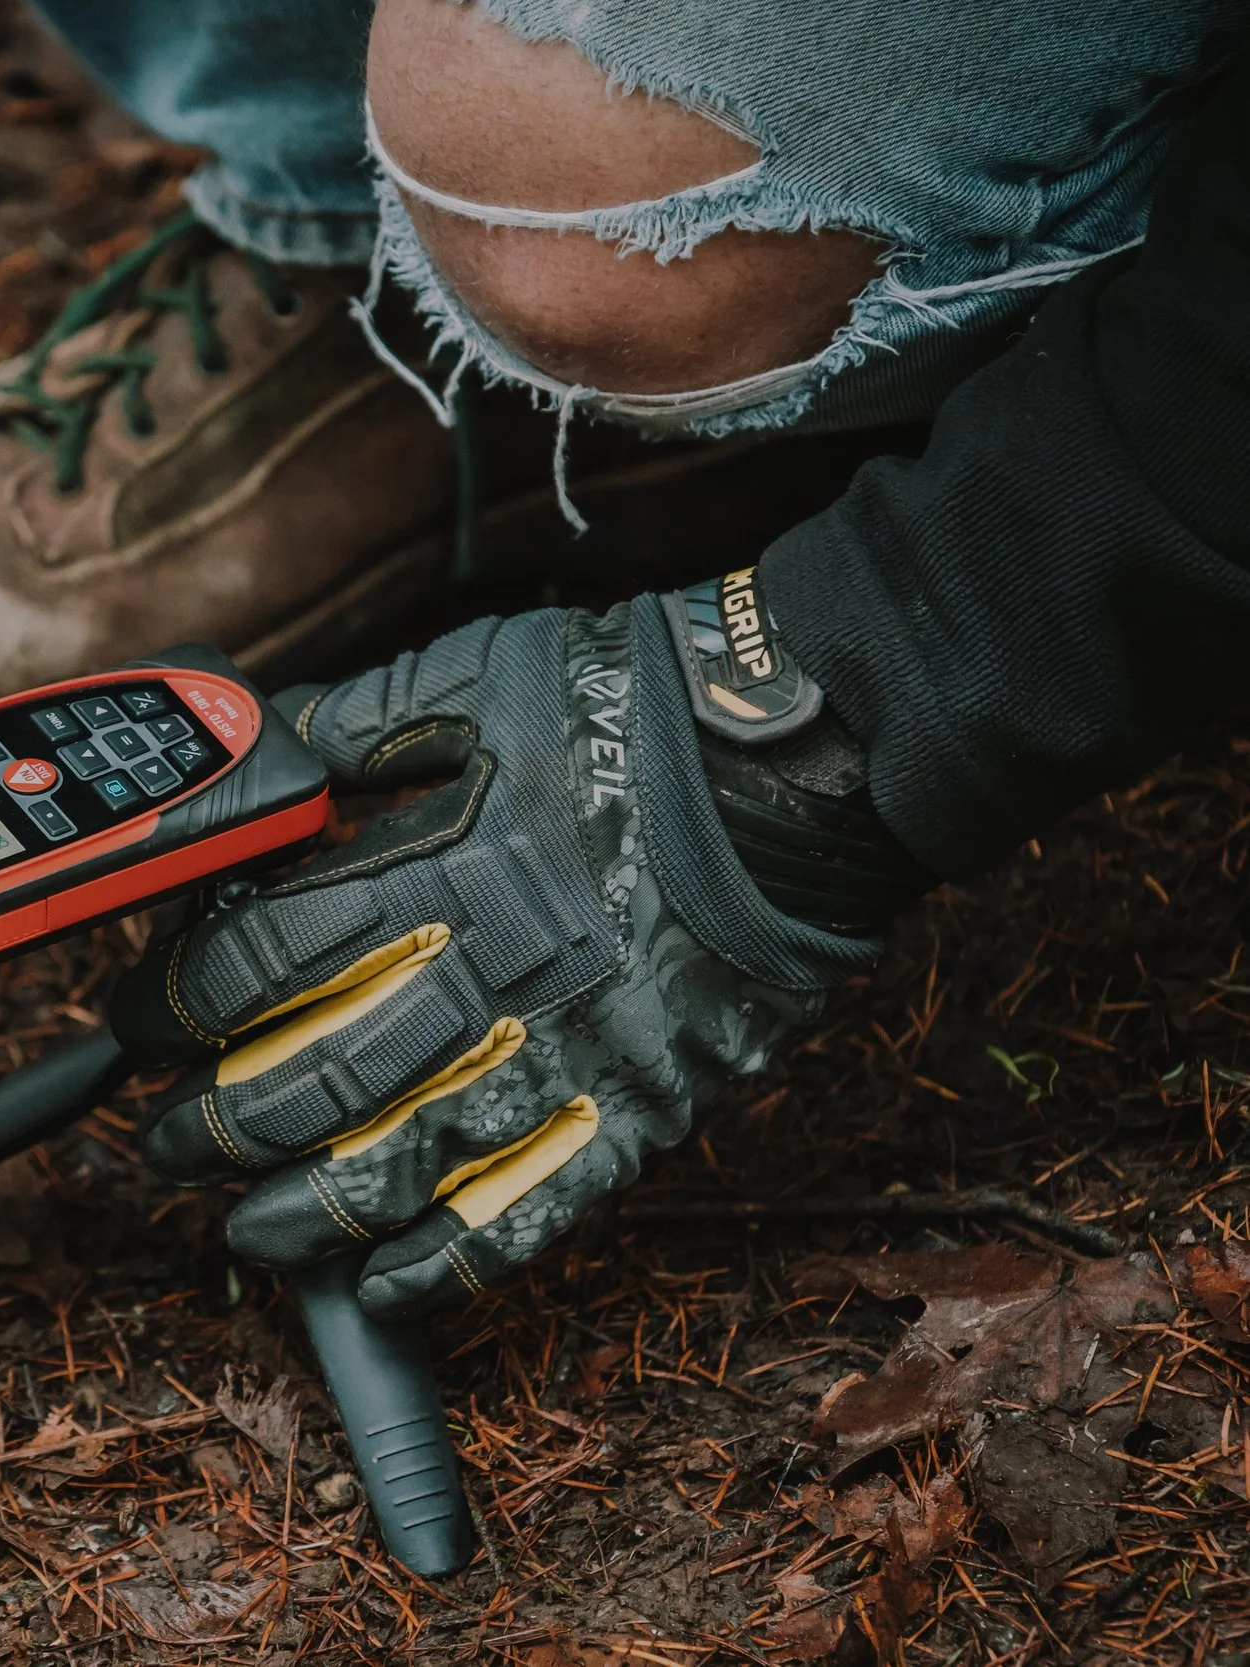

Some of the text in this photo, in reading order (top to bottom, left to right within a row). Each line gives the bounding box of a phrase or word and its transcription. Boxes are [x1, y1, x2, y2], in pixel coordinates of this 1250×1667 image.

[215, 697, 239, 719] touch
[46, 712, 66, 730] FUNC
[588, 708, 626, 807] VEIL
[20, 769, 36, 782] ON
[31, 763, 51, 779] DIST
